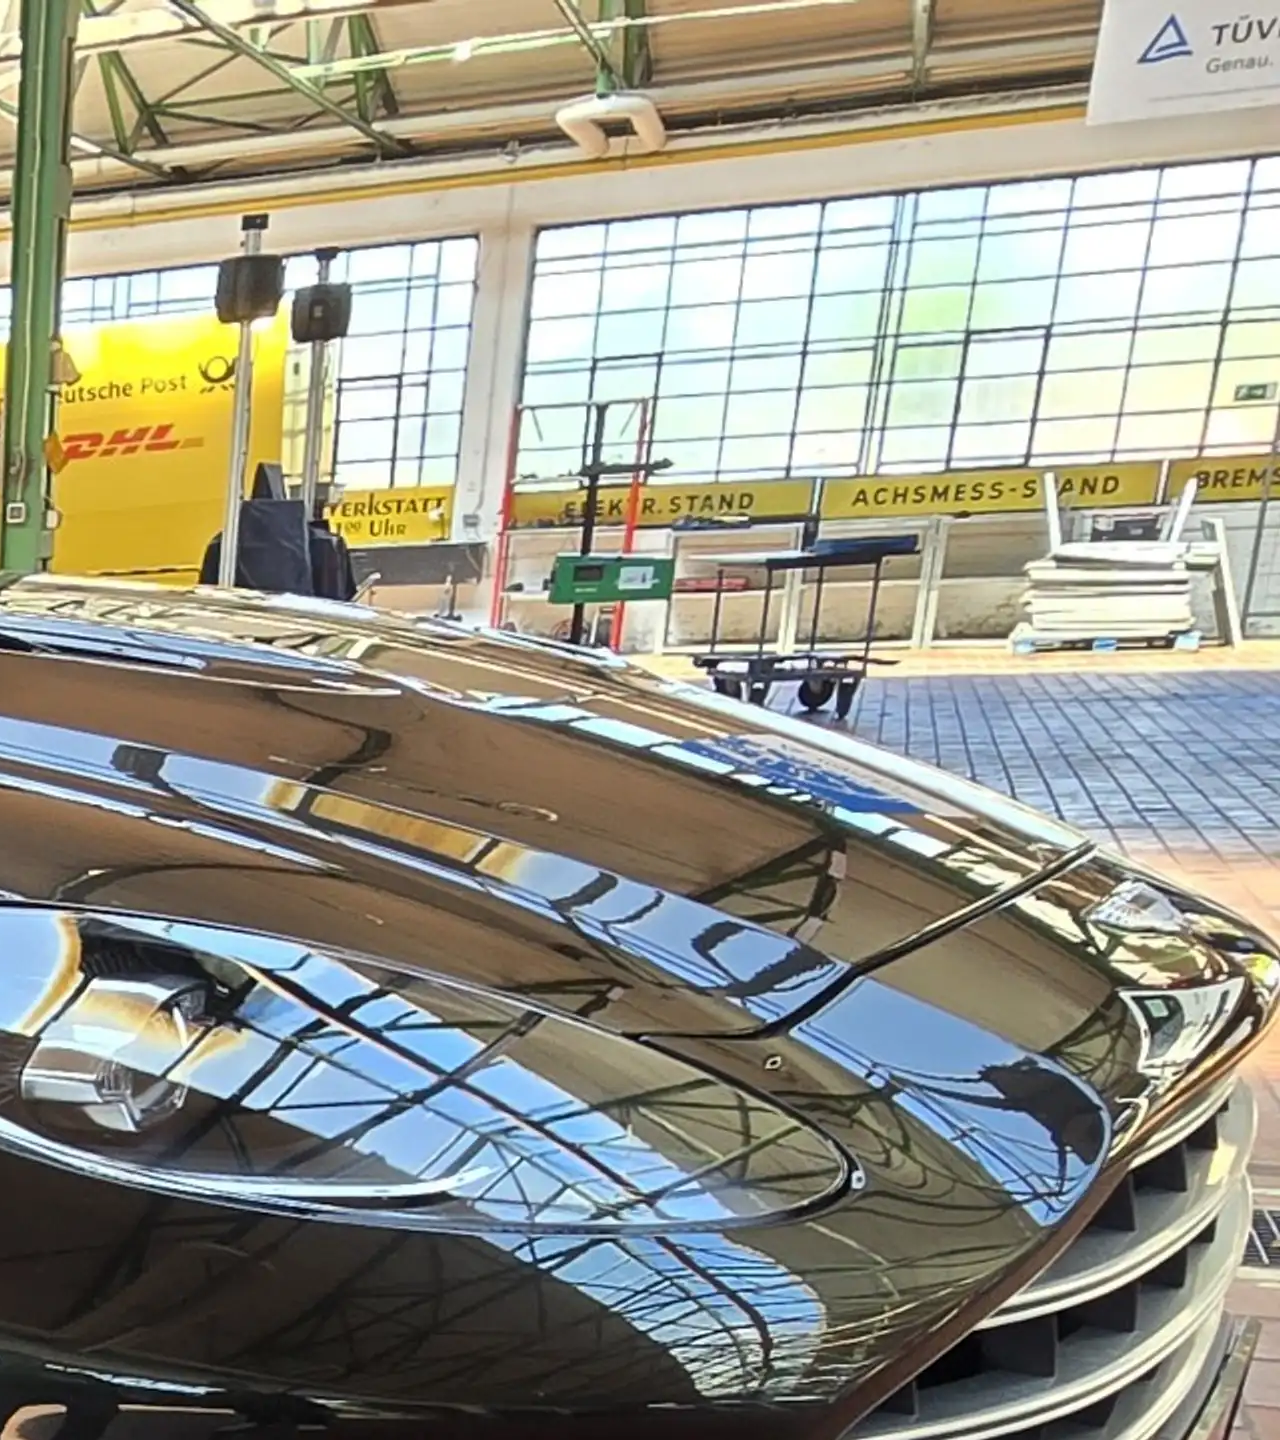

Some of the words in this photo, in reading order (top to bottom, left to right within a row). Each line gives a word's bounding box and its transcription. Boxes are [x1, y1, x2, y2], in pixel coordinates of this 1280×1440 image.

[1211, 14, 1280, 46] TÜV
[1206, 55, 1274, 73] Genau.
[58, 381, 133, 404] utsche
[140, 375, 187, 394] Post
[62, 422, 180, 460] DHL
[669, 491, 755, 514] STAND
[852, 475, 1120, 507] ACHSMESS-SAND
